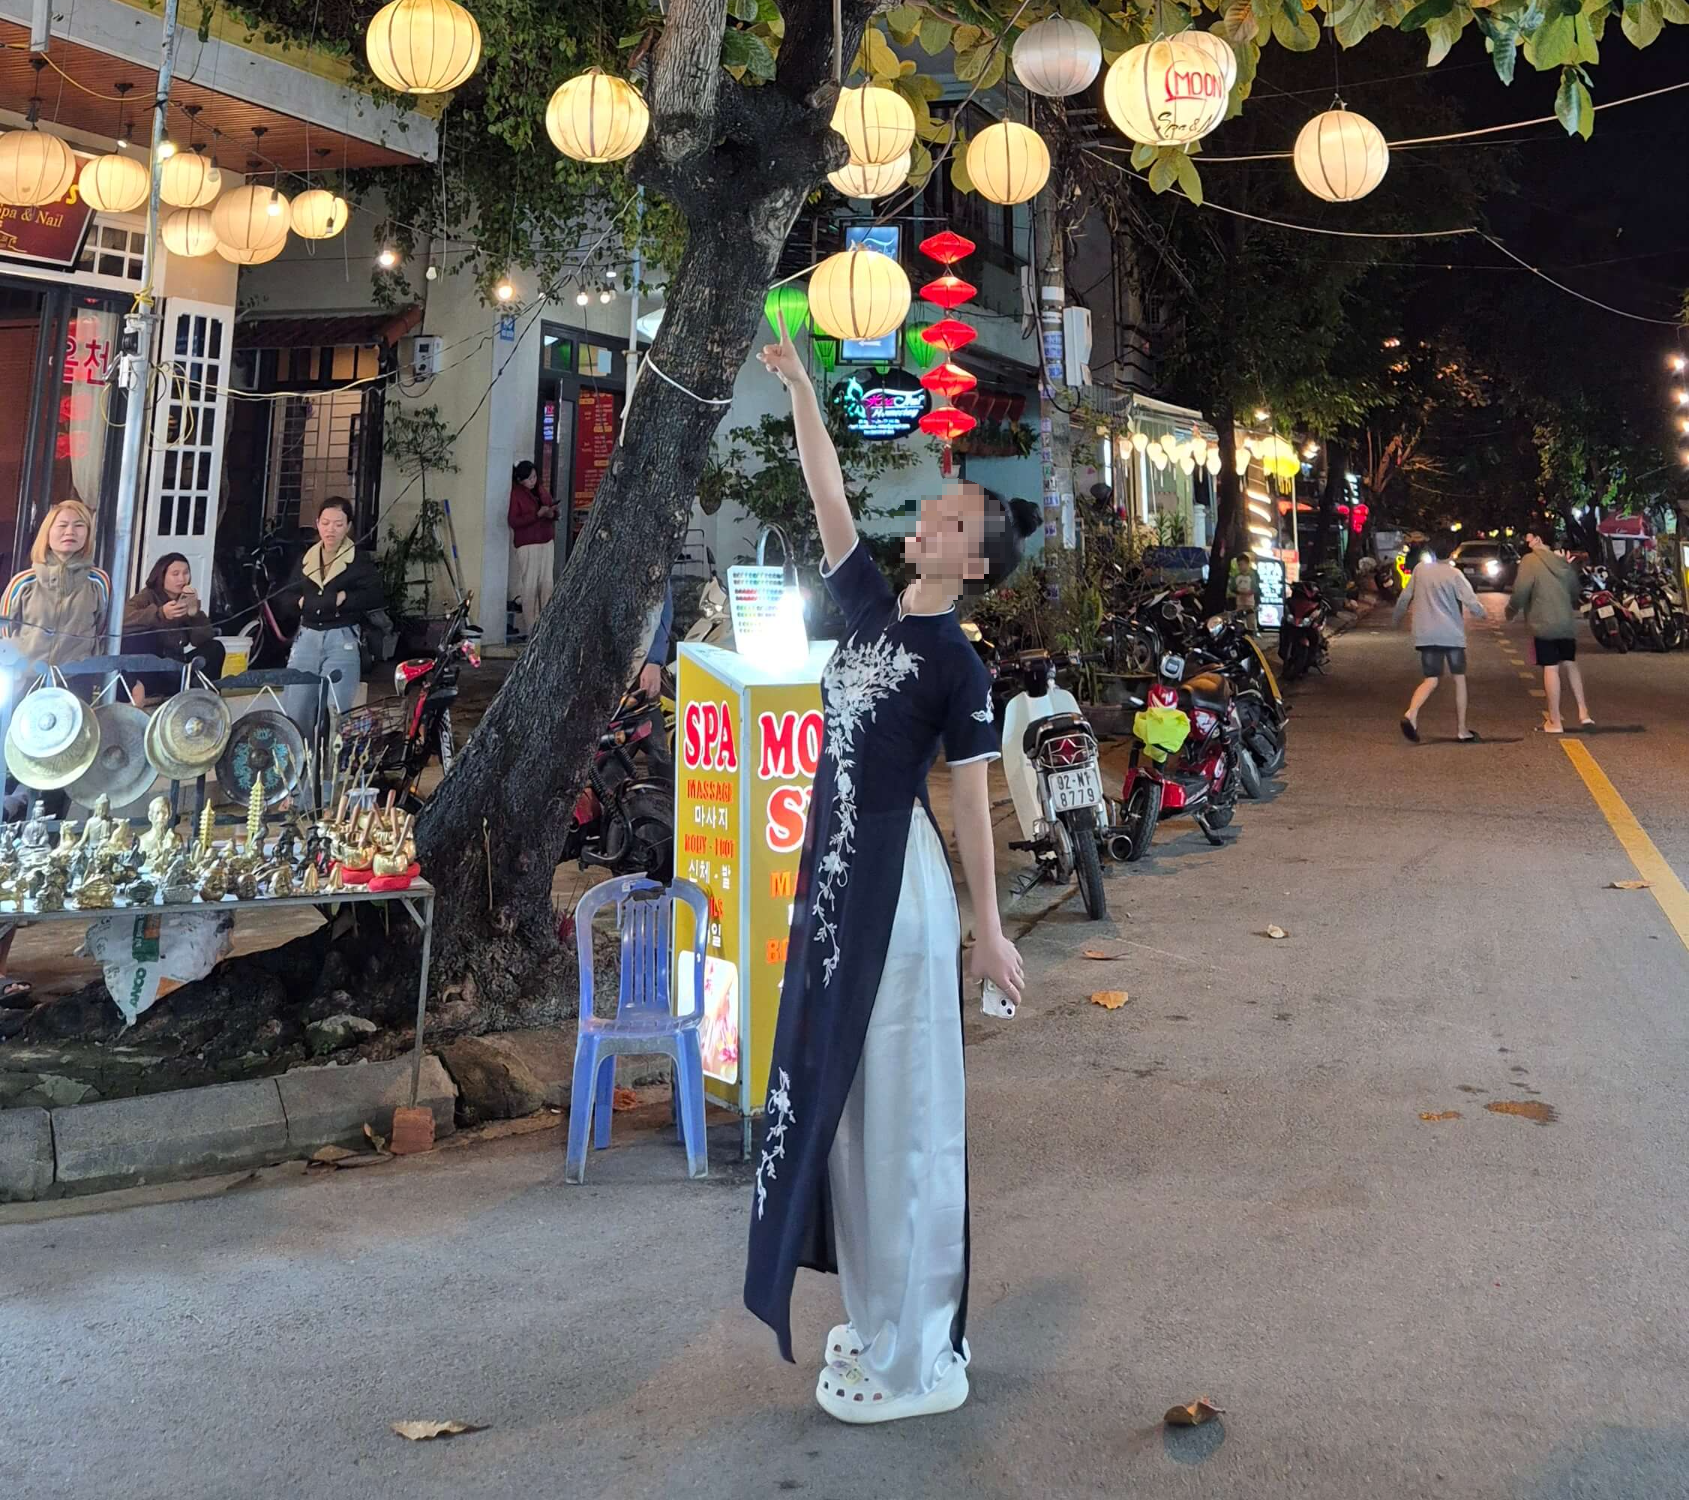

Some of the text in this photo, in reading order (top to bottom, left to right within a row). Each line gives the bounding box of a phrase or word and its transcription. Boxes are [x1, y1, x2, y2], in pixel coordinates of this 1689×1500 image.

[1174, 71, 1223, 98] MOON
[35, 210, 64, 228] Nail
[684, 700, 738, 773] SPA
[758, 710, 824, 780] MO
[687, 779, 733, 804] MASSAGE
[1060, 788, 1095, 807] 8779
[694, 804, 728, 831] 마사지
[766, 785, 813, 852] S
